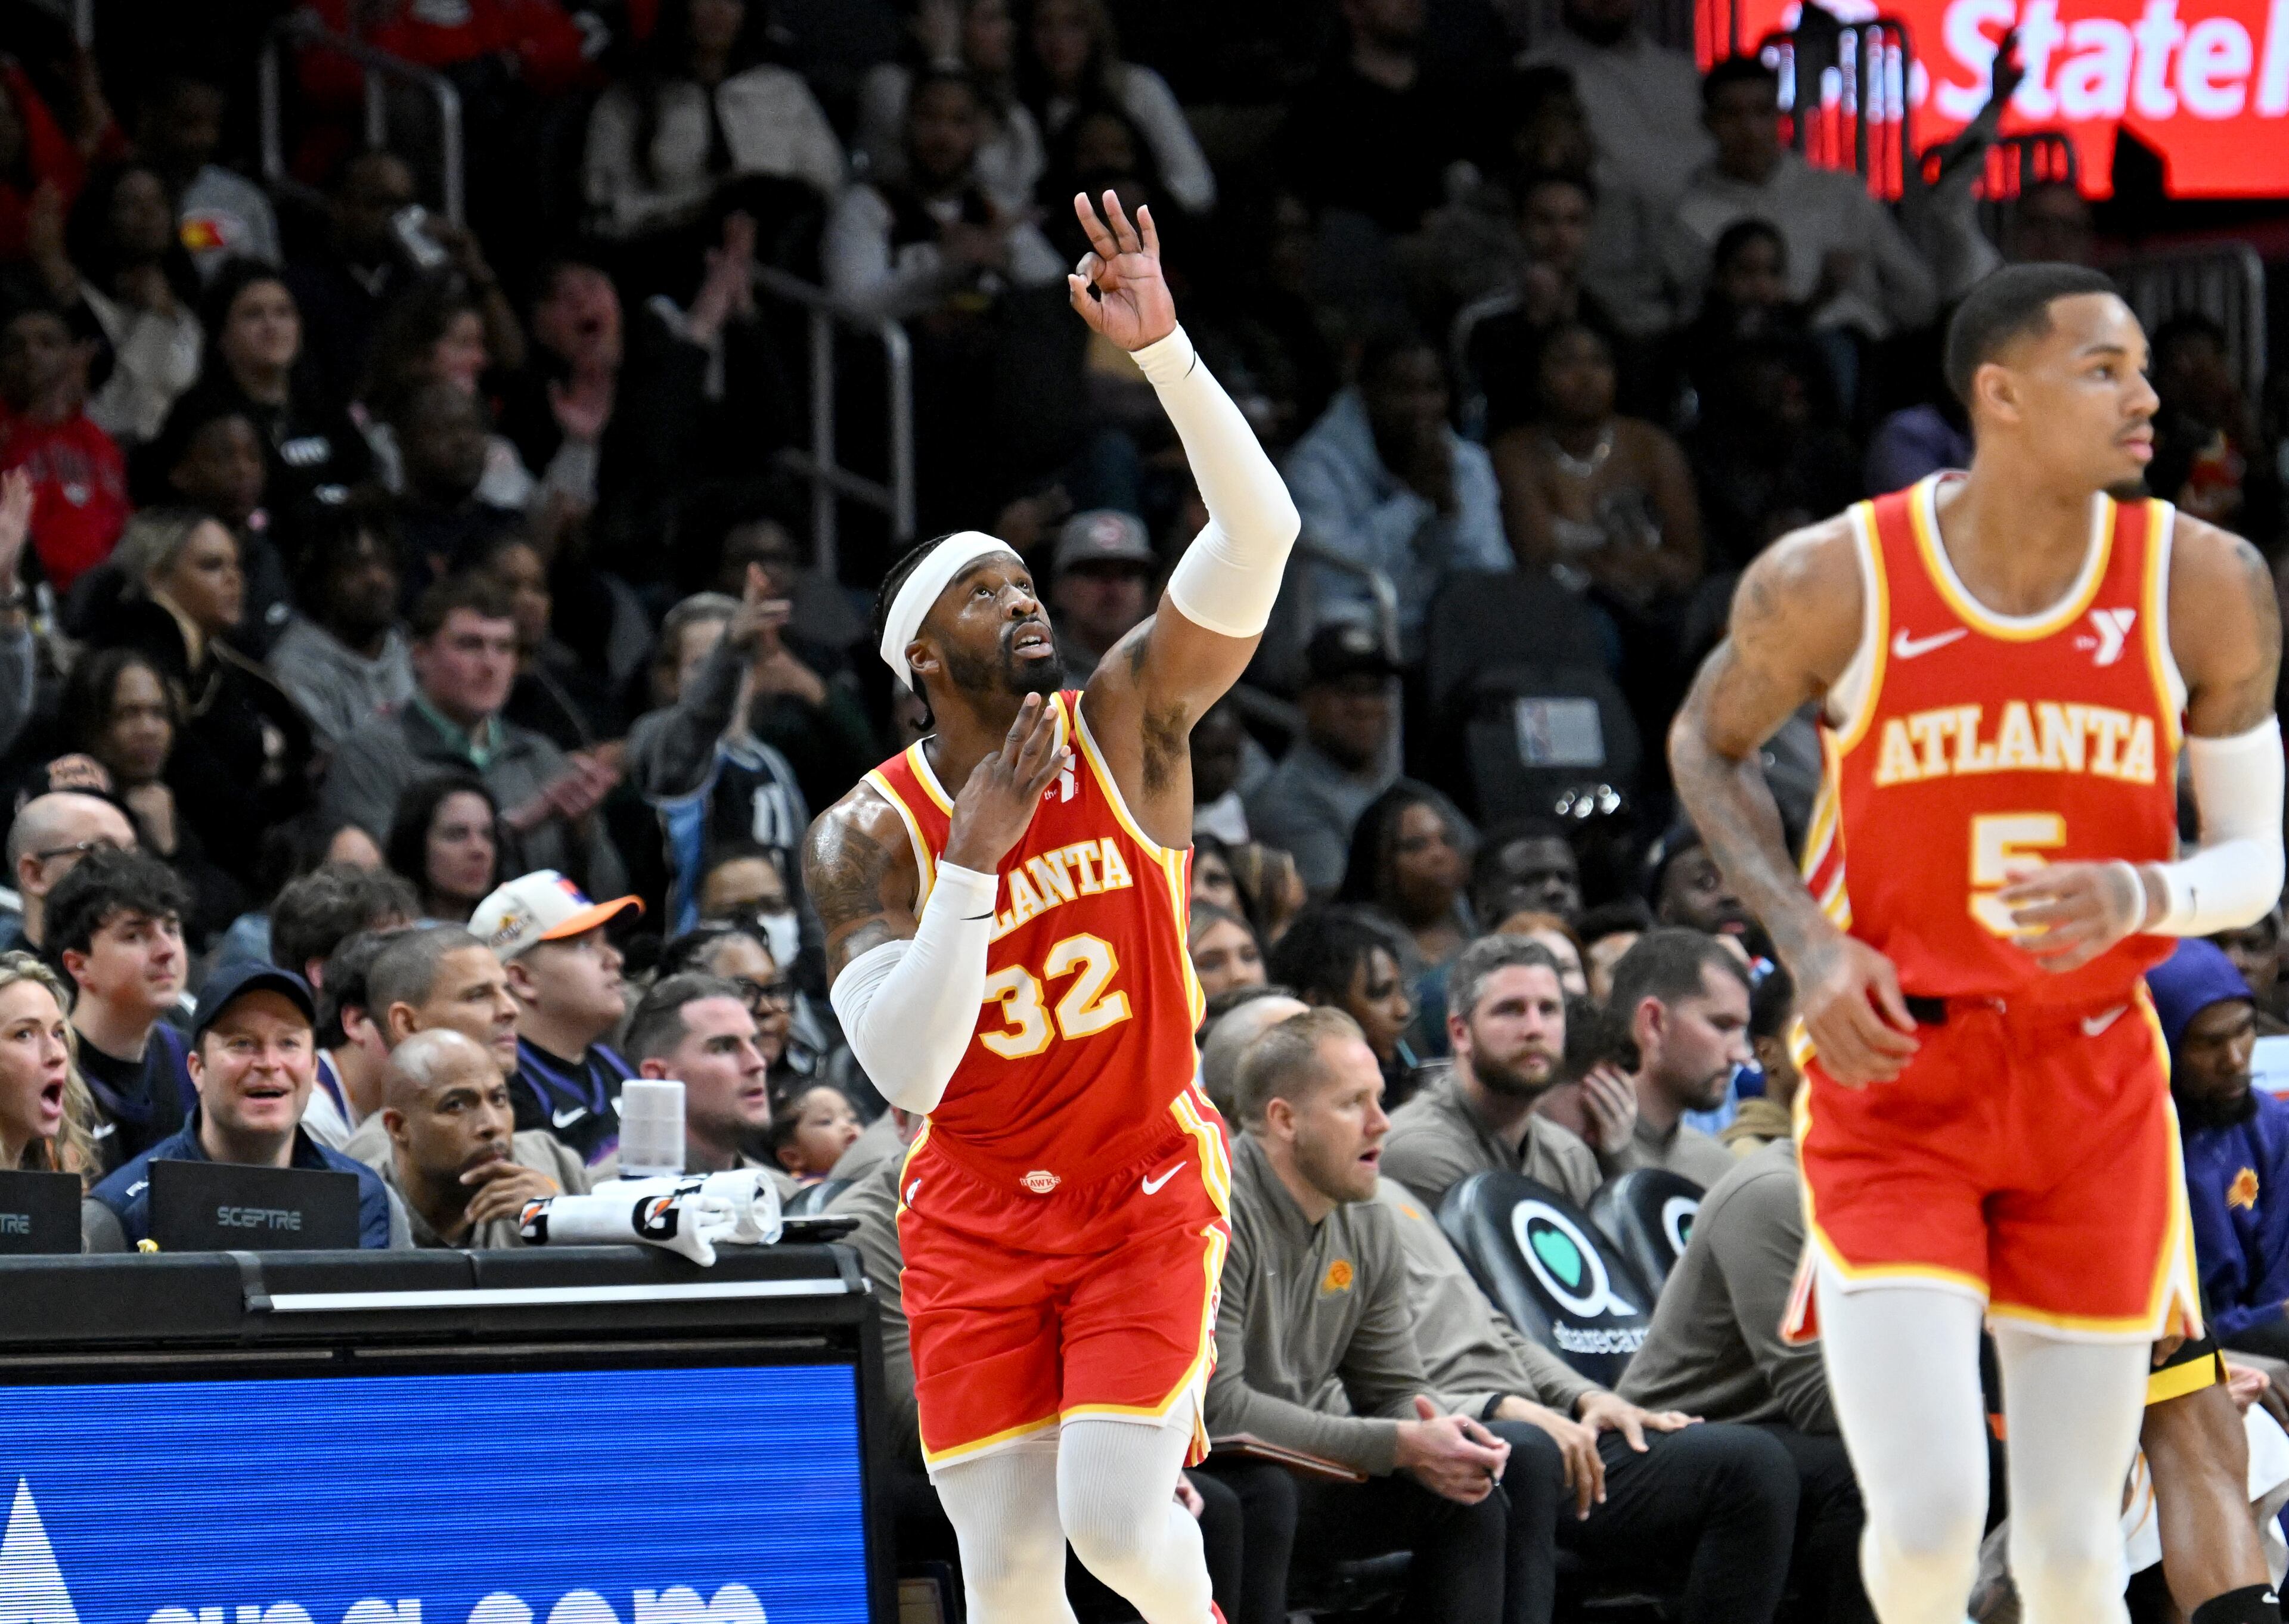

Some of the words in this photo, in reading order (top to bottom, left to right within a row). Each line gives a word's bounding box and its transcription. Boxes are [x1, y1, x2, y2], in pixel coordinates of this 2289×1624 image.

[1874, 698, 2158, 787] ATLANTA
[988, 836, 1134, 945] LANTA
[1969, 811, 2066, 938] 5
[978, 931, 1133, 1060] 32
[217, 1206, 302, 1231] SCEPTRE
[1019, 1176, 1062, 1187] HAWKS
[1553, 1319, 1651, 1355] sharecar
